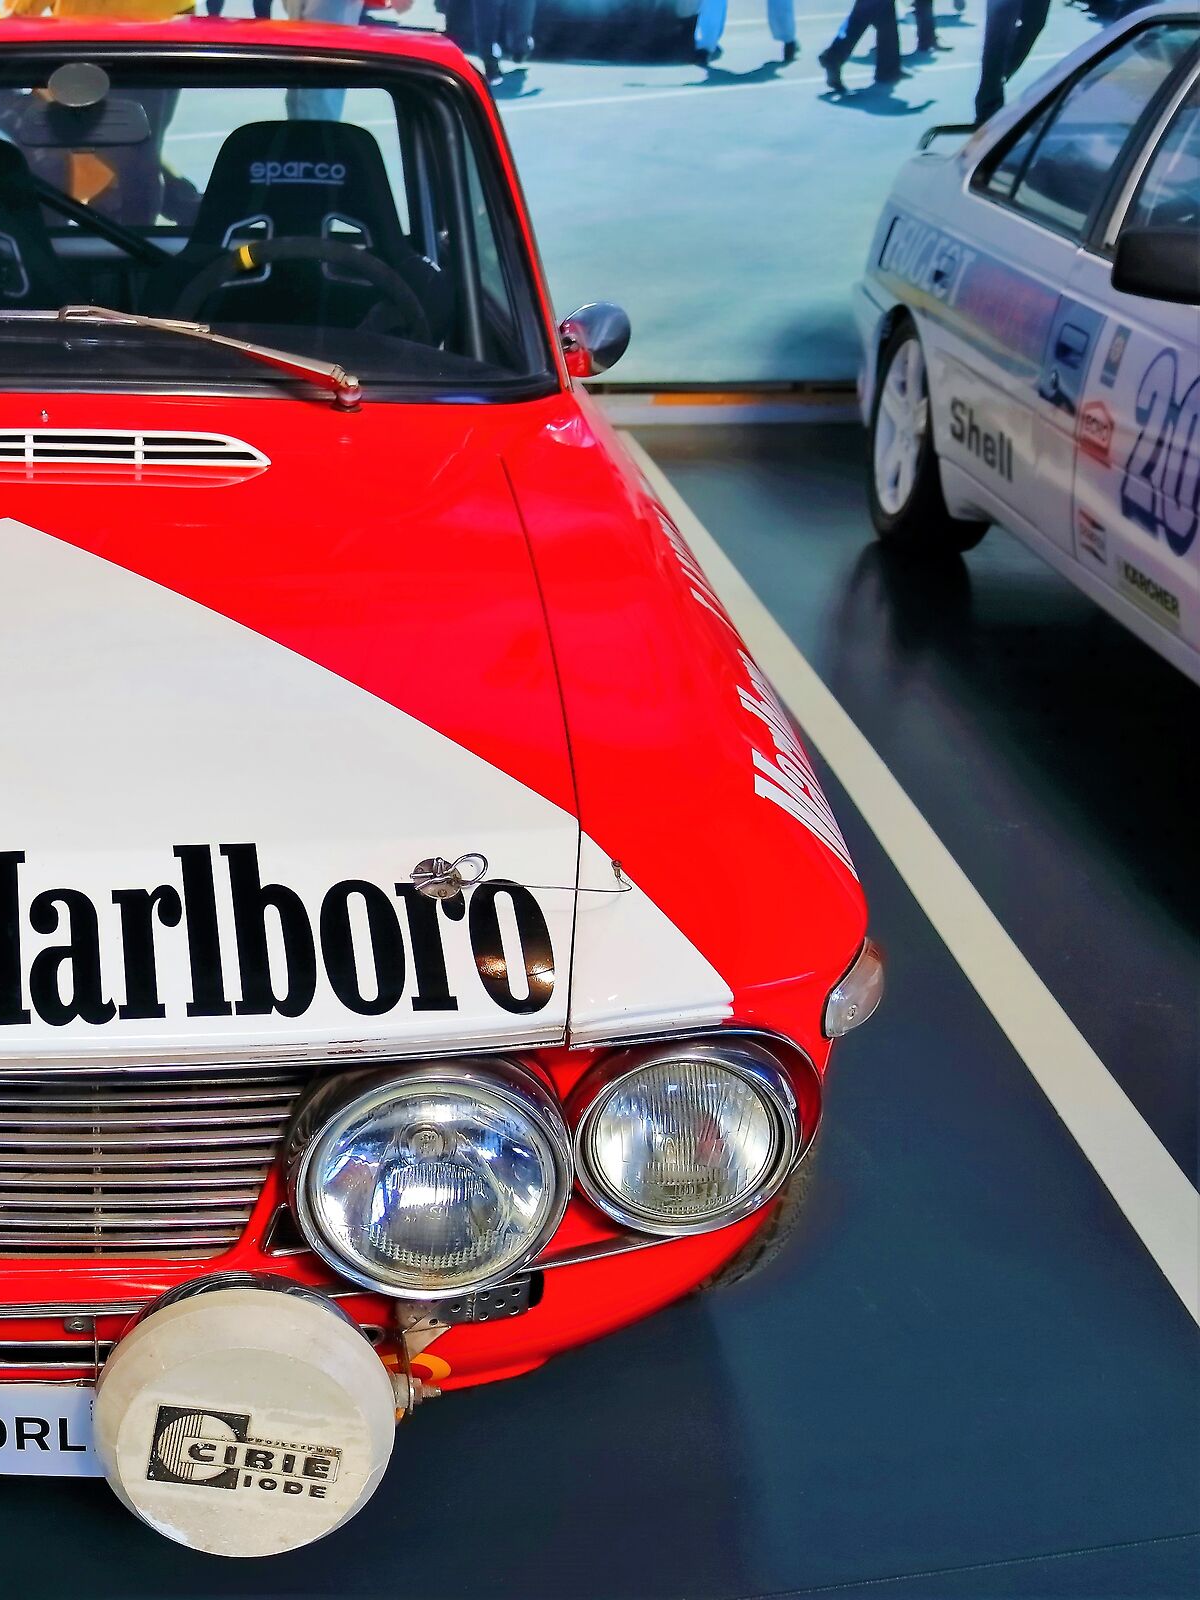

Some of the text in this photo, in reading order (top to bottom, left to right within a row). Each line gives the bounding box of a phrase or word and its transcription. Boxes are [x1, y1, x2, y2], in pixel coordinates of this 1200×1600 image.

[250, 162, 346, 185] sparco
[950, 396, 1013, 484] Shell
[243, 1475, 328, 1499] IODE
